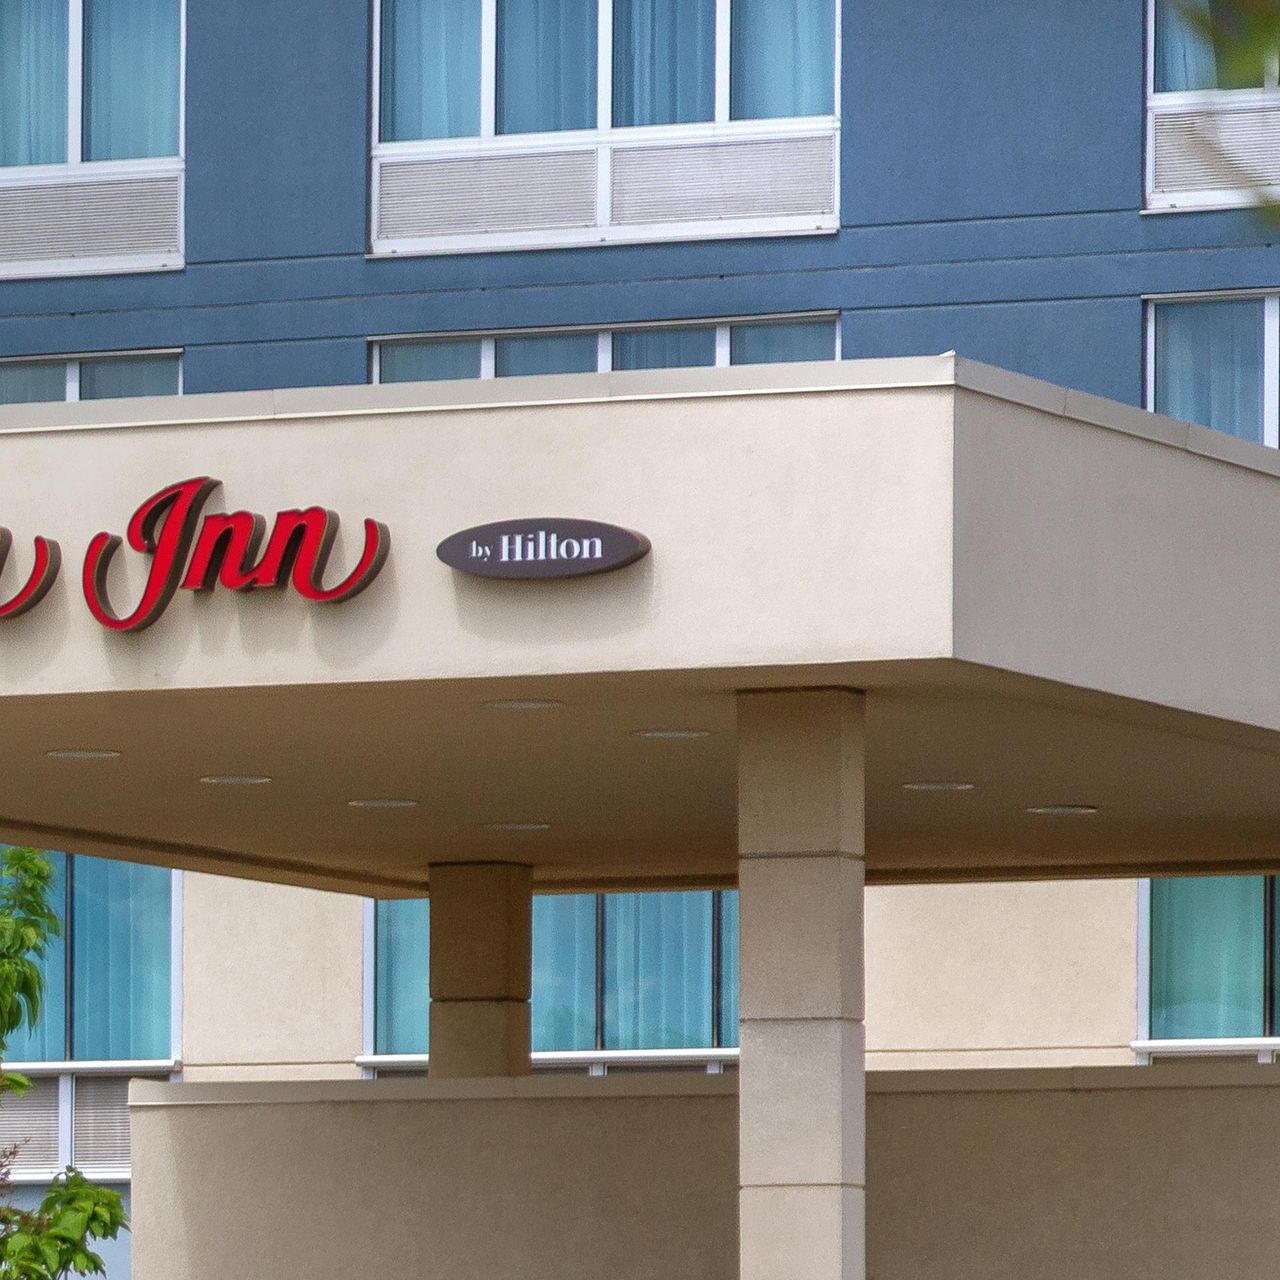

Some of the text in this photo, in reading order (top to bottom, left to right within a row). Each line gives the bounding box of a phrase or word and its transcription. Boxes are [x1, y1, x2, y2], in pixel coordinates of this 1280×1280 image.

[82, 476, 391, 631] Inn
[470, 530, 603, 562] by Hilton
